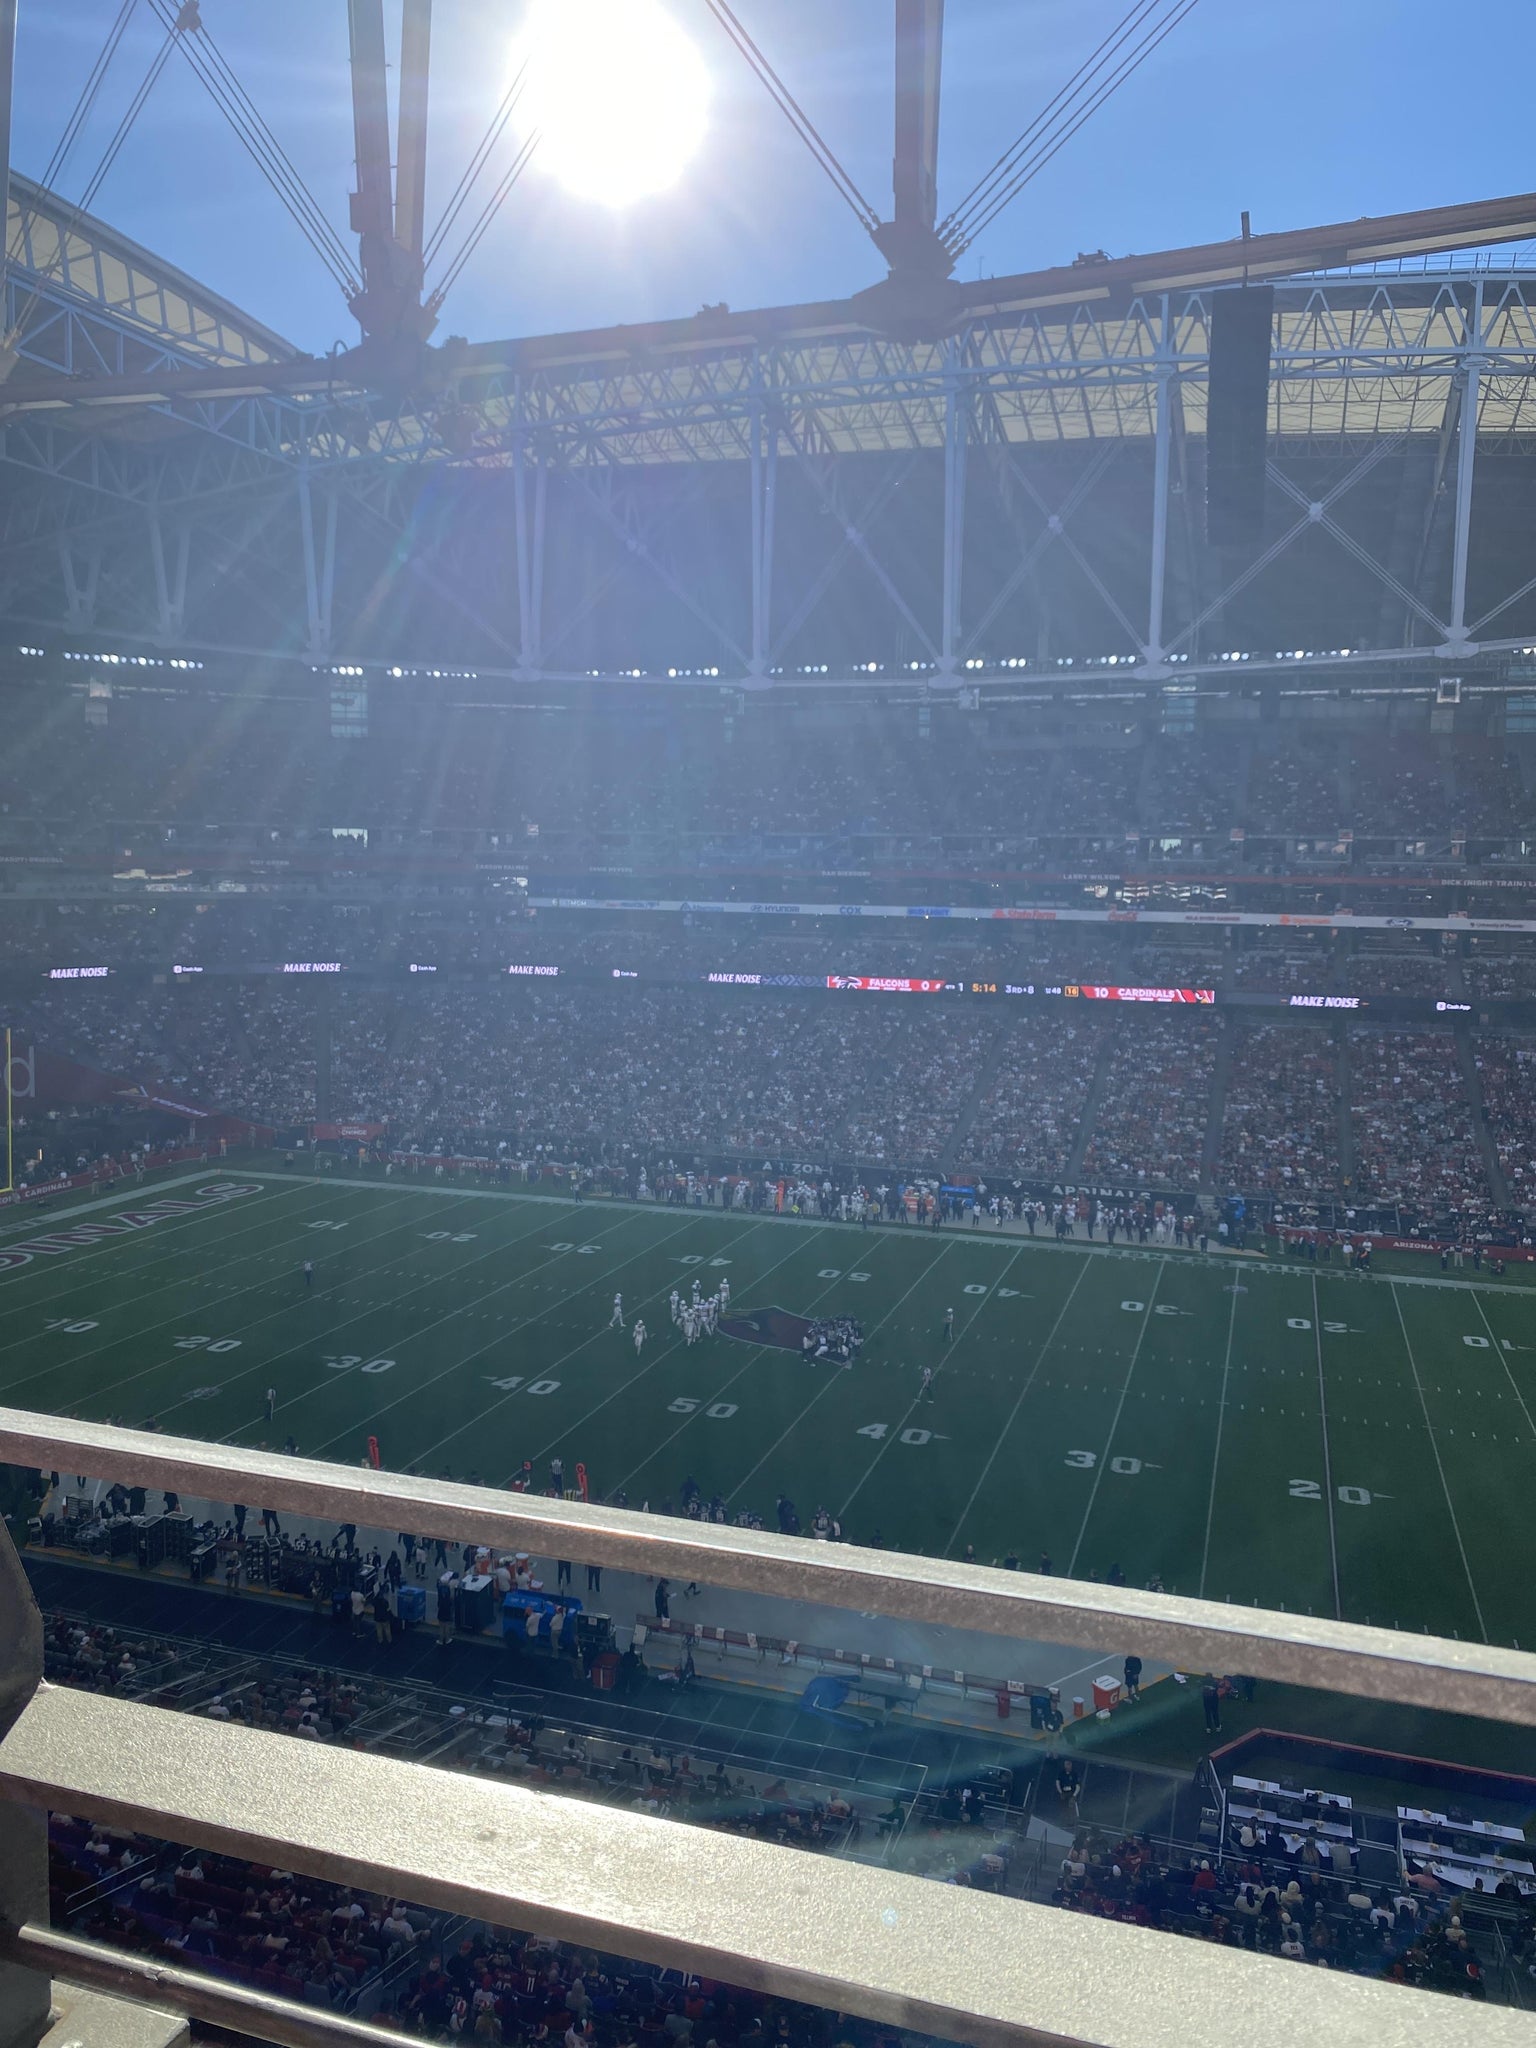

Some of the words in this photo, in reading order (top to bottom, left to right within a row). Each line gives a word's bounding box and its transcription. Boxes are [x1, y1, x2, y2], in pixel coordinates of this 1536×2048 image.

[839, 906, 862, 914] COX
[50, 968, 79, 979] MAKE
[80, 967, 108, 977] NOISE
[284, 963, 311, 972] MAKE
[312, 963, 341, 972] NOISE
[509, 965, 533, 974] MAKE
[534, 966, 558, 976] NOISE
[708, 973, 734, 983] MAKE
[735, 974, 761, 984] NOISE
[869, 979, 910, 988] FALCONS
[921, 980, 930, 990] 0
[958, 983, 963, 992] 1
[972, 983, 997, 992] 5:14
[1094, 987, 1109, 998] 10
[1118, 988, 1175, 999] CARDINALS
[1290, 995, 1324, 1007] MAKE
[1325, 997, 1360, 1008] NOISE
[25, 1180, 73, 1198] CARDINALS
[1393, 1241, 1434, 1250] ARIZONA
[173, 1336, 242, 1352] 20
[327, 1355, 396, 1373] 30
[490, 1376, 561, 1394] 40
[667, 1397, 739, 1418] 50
[856, 1423, 932, 1445] 40
[1063, 1450, 1142, 1475] 30
[1288, 1478, 1372, 1506] 20
